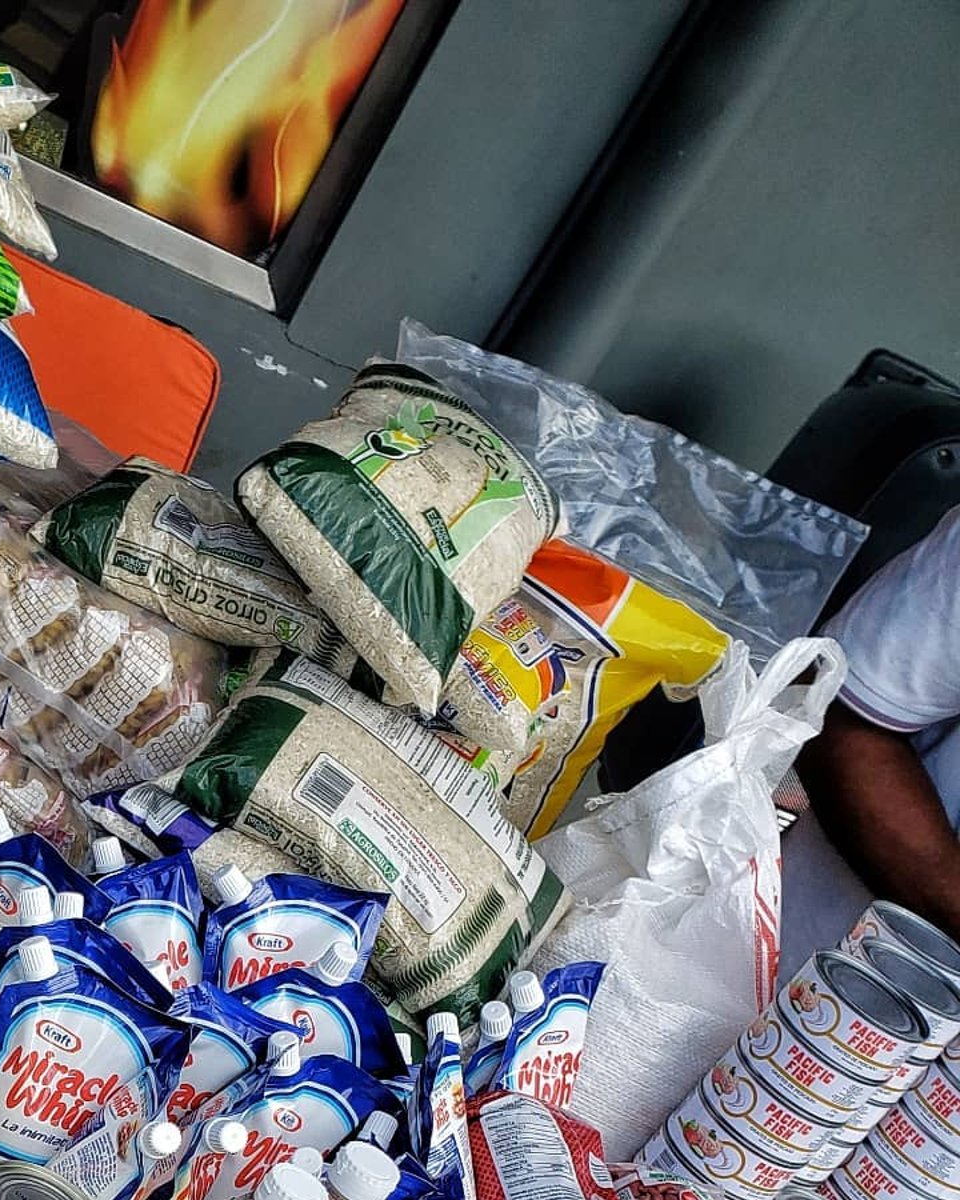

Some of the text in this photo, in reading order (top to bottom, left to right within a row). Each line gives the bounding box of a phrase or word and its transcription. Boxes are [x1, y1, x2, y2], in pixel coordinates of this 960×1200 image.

[214, 600, 267, 625] arroz
[255, 937, 285, 950] Kraft
[42, 1025, 74, 1048] Kraft
[847, 1036, 880, 1058] FISH
[849, 1020, 898, 1052] PACIFIC
[2, 1045, 120, 1106] Miracl
[784, 1060, 815, 1088] FISH
[787, 1044, 835, 1085] PACIFIC
[927, 1092, 954, 1118] FISH
[931, 1077, 960, 1114] PACIF
[1, 1119, 20, 1133] La
[763, 1116, 795, 1141] FISH
[765, 1103, 813, 1136] PACIFIC
[889, 1108, 926, 1149] PACIFIC
[884, 1122, 909, 1149] FISH
[855, 1169, 881, 1196] FISH
[859, 1155, 899, 1195] PACIFIC
